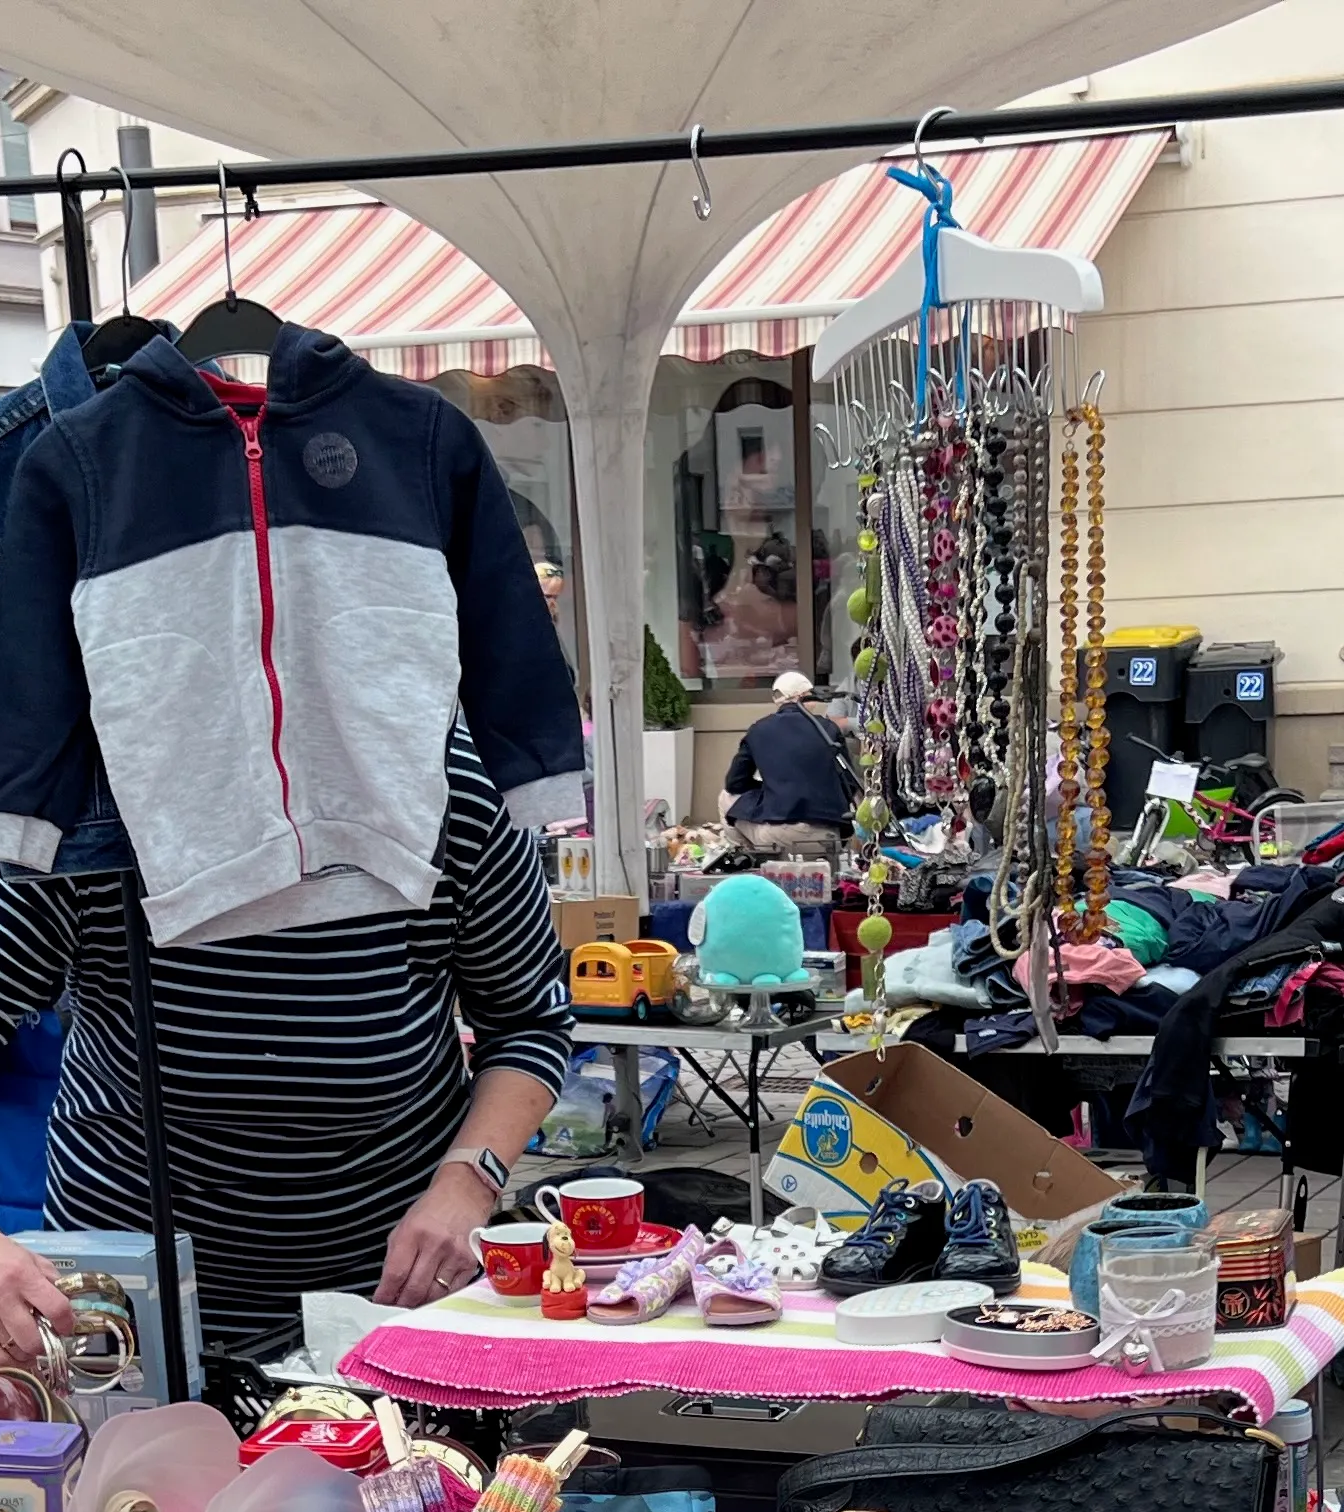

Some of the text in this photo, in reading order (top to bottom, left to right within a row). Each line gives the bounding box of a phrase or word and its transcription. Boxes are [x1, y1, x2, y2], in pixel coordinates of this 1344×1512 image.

[1133, 661, 1154, 682] 22
[1240, 677, 1261, 697] 22
[803, 1108, 851, 1131] Chiquita
